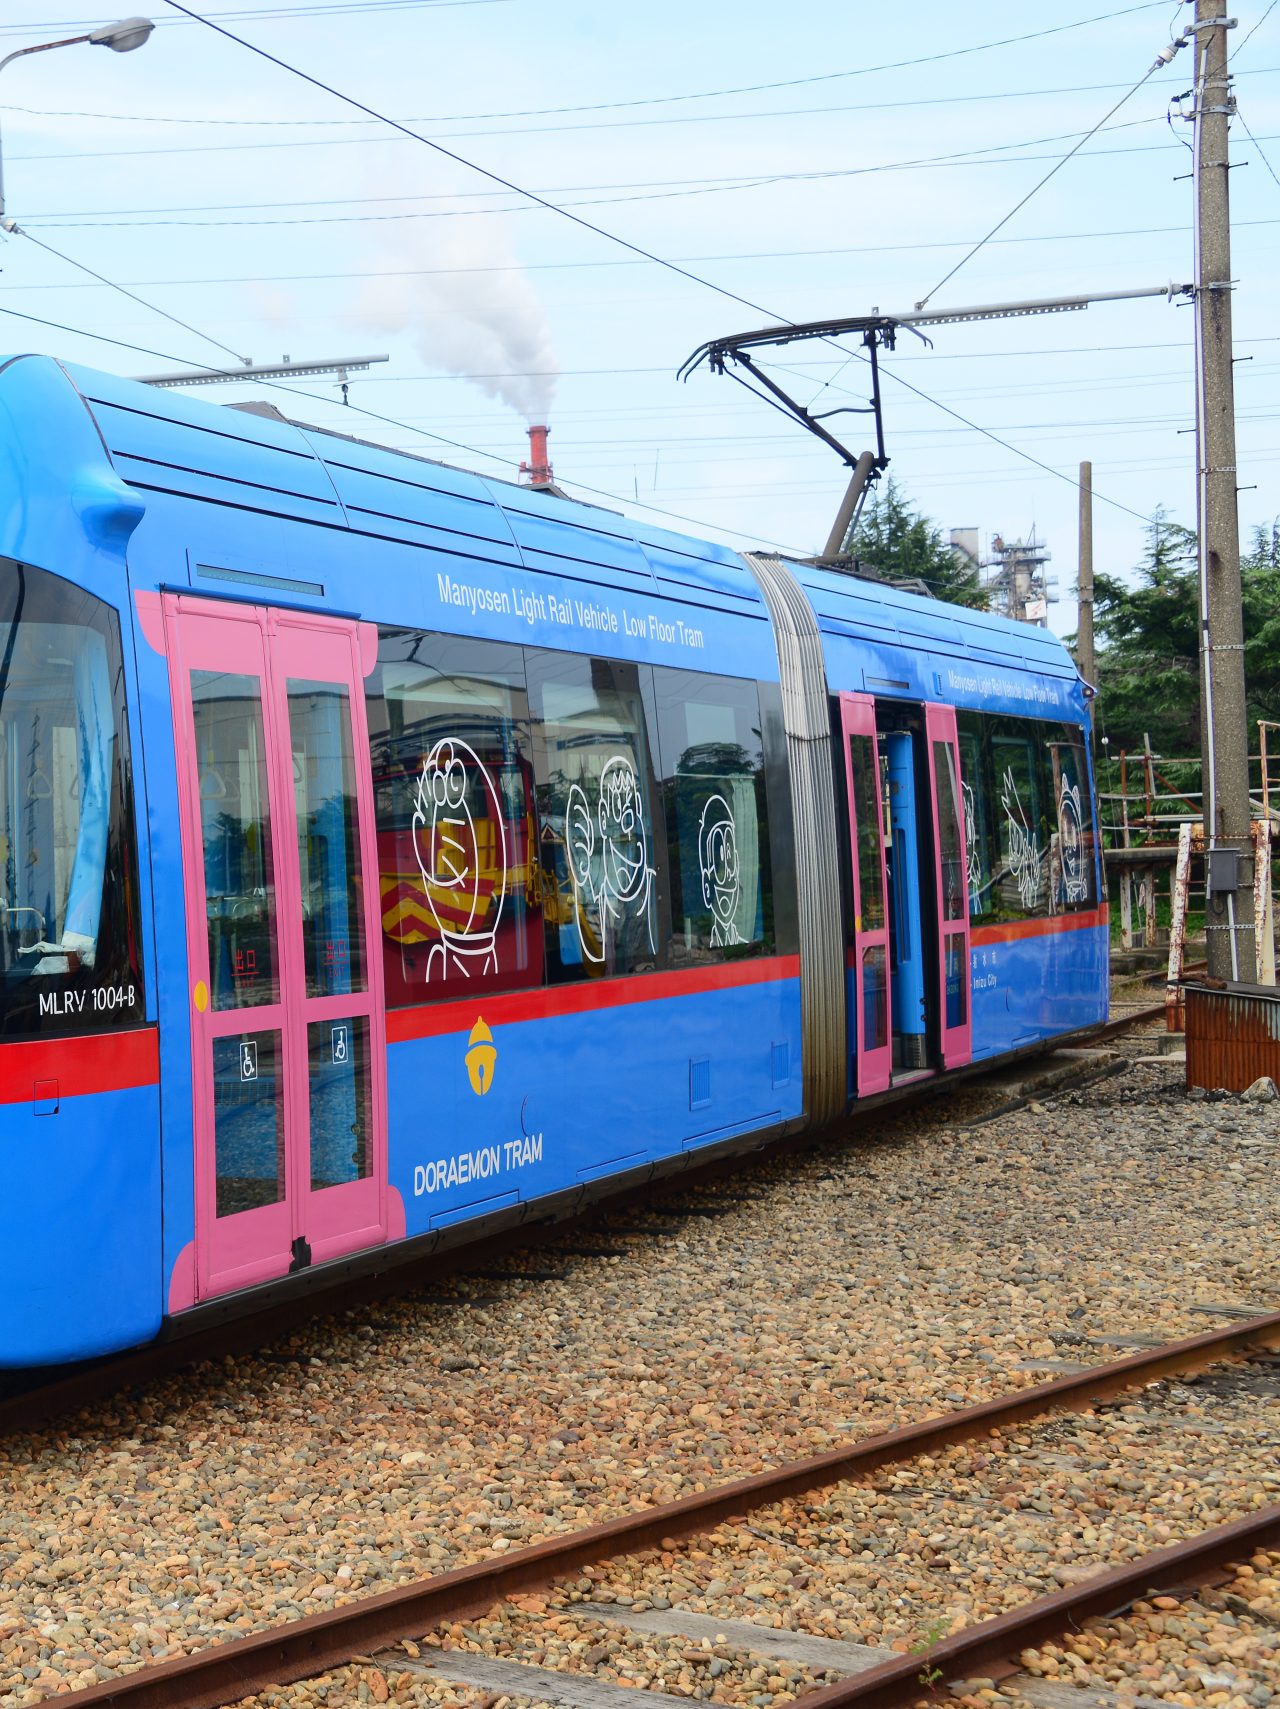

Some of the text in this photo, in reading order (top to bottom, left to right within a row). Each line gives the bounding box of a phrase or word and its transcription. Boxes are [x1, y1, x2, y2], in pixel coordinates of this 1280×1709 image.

[437, 573, 705, 649] Manyosen Light Rail Vehicle Low Floor Tram
[948, 670, 1059, 705] Manyosen Light Rail Vehicle Low Floor Tram
[234, 949, 256, 971] 出口
[39, 985, 135, 1015] MLRV 1004-B
[414, 1132, 543, 1197] DORAEMON TRAM
